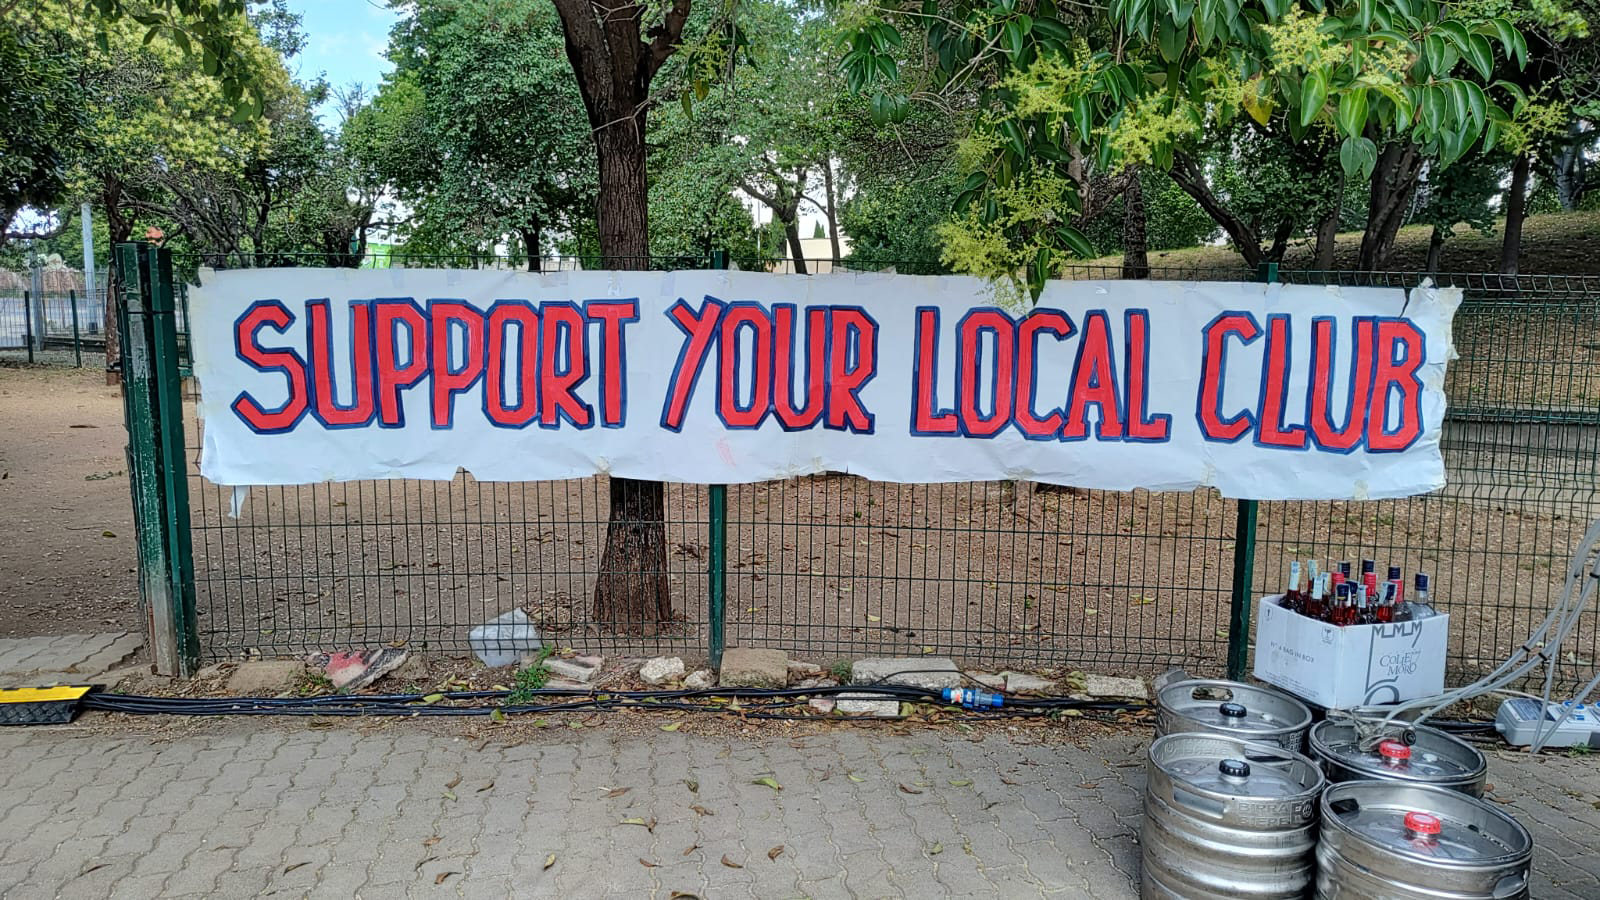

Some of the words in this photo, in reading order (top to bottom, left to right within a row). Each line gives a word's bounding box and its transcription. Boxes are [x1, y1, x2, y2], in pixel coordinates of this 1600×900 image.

[230, 297, 640, 435] SUPPORT
[660, 296, 879, 434] YOUR
[910, 305, 1172, 443] LOCAL
[1196, 309, 1426, 455] CLUB
[1238, 802, 1289, 814] BIRRA
